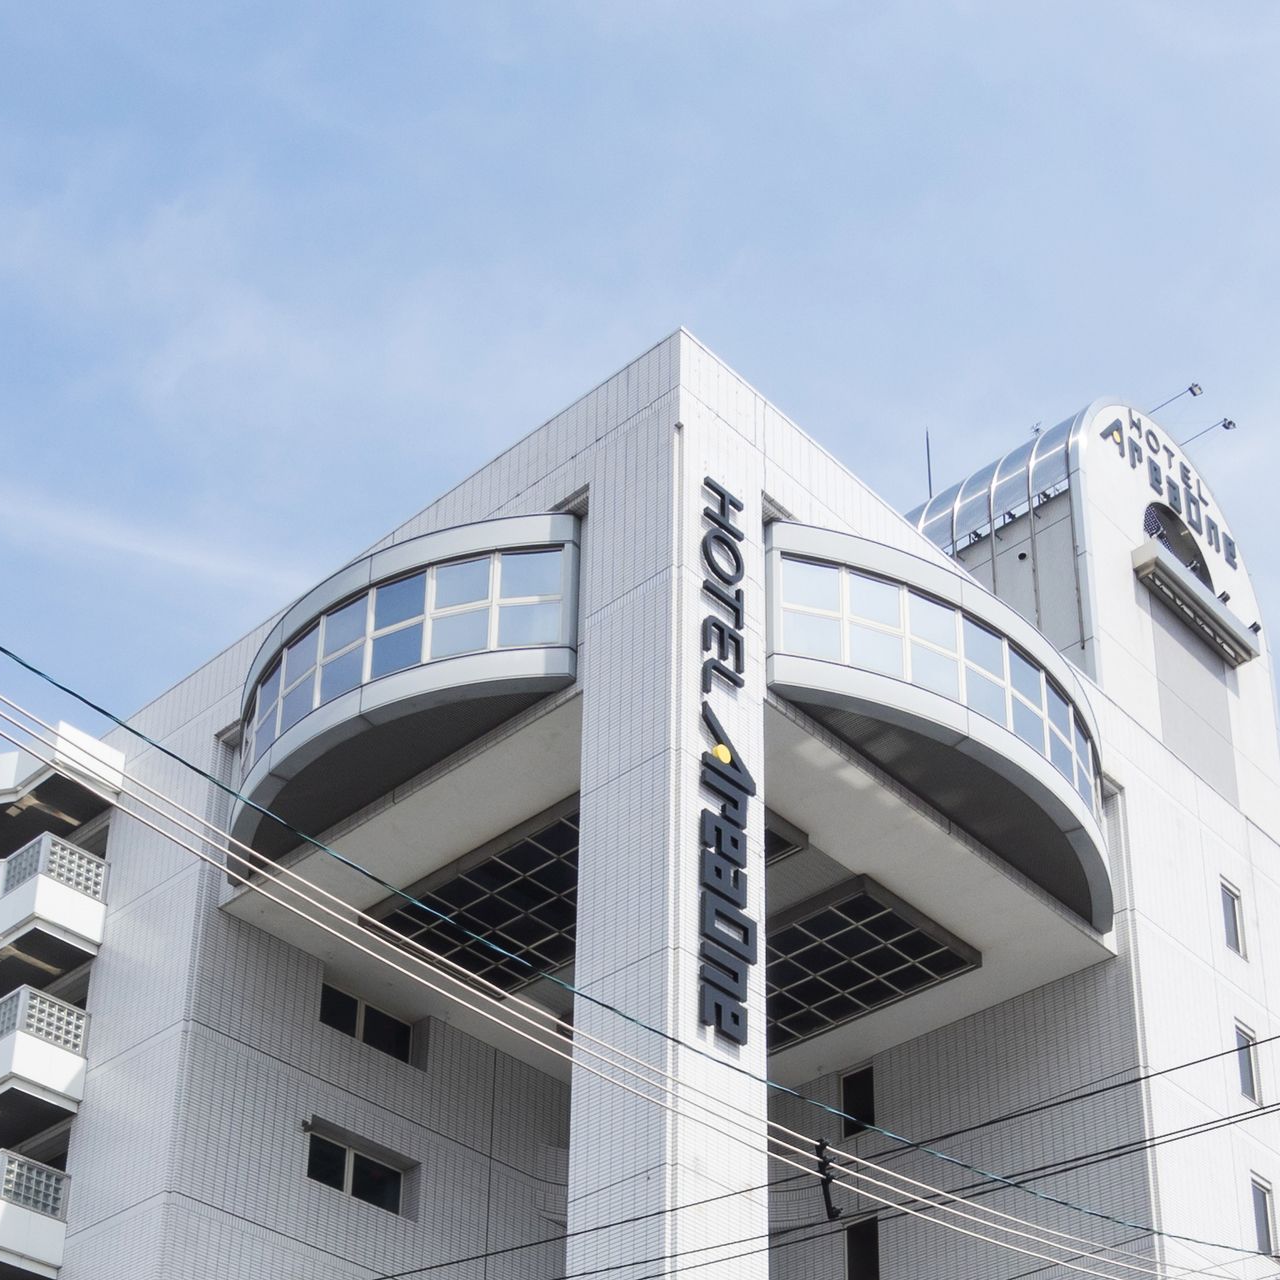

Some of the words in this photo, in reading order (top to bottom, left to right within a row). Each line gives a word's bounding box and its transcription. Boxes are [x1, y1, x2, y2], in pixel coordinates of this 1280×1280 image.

[1099, 418, 1237, 570] AreaOne
[1127, 408, 1209, 507] HOTEL
[703, 475, 745, 693] HOTEL
[699, 700, 757, 1046] AreaOne
